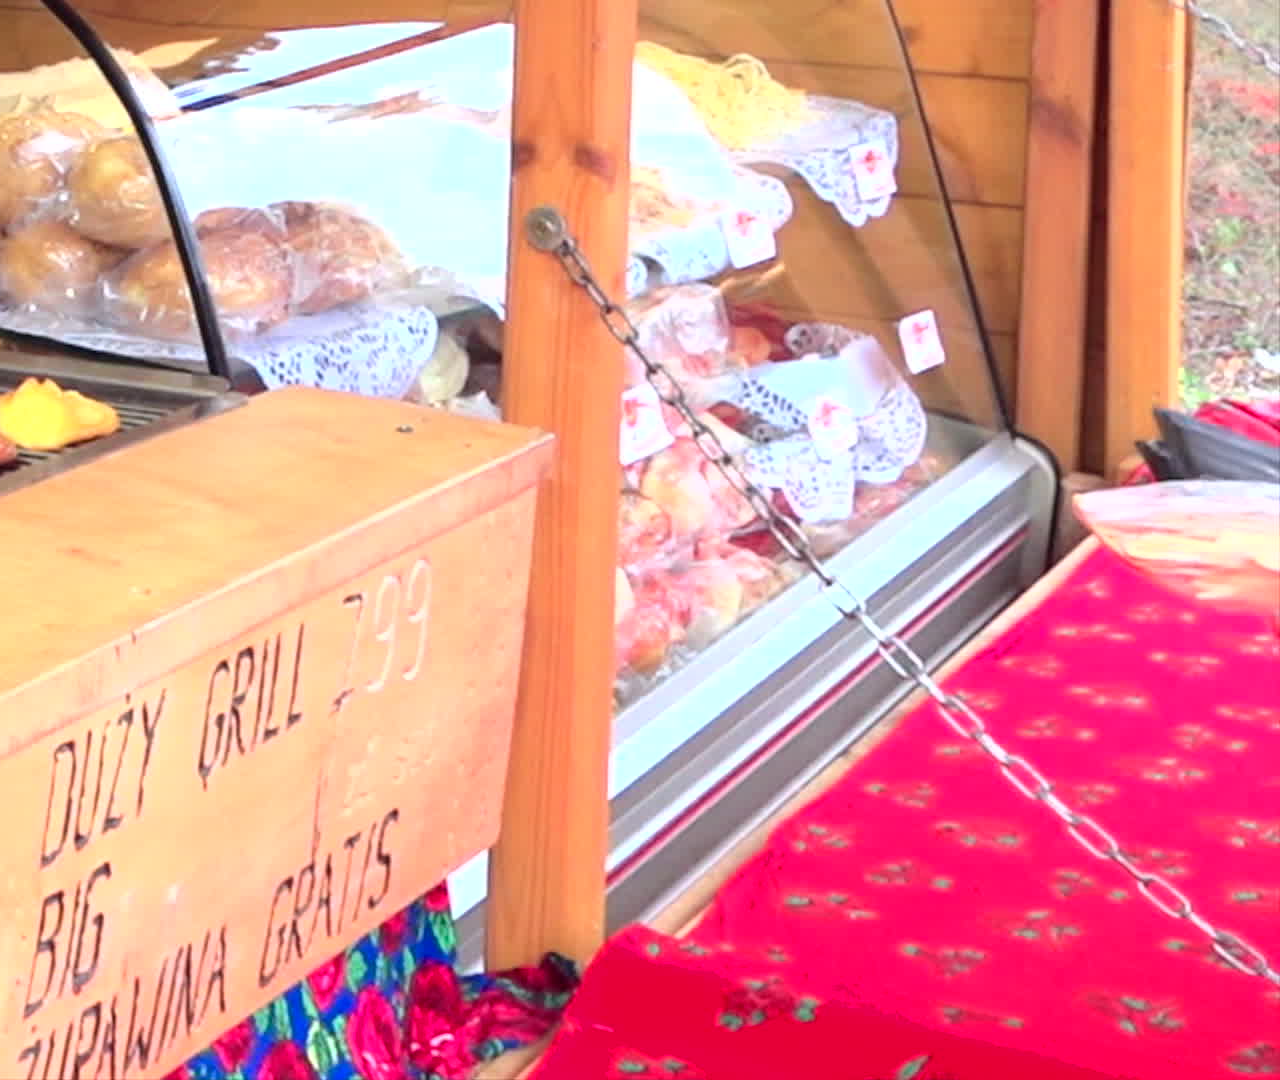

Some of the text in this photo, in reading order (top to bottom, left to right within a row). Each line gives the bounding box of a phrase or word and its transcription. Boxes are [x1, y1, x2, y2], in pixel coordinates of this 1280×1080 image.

[41, 688, 167, 869] DUŻY
[198, 623, 305, 792] GRILL
[23, 861, 112, 1019] BIG
[258, 808, 399, 988] GRATIS
